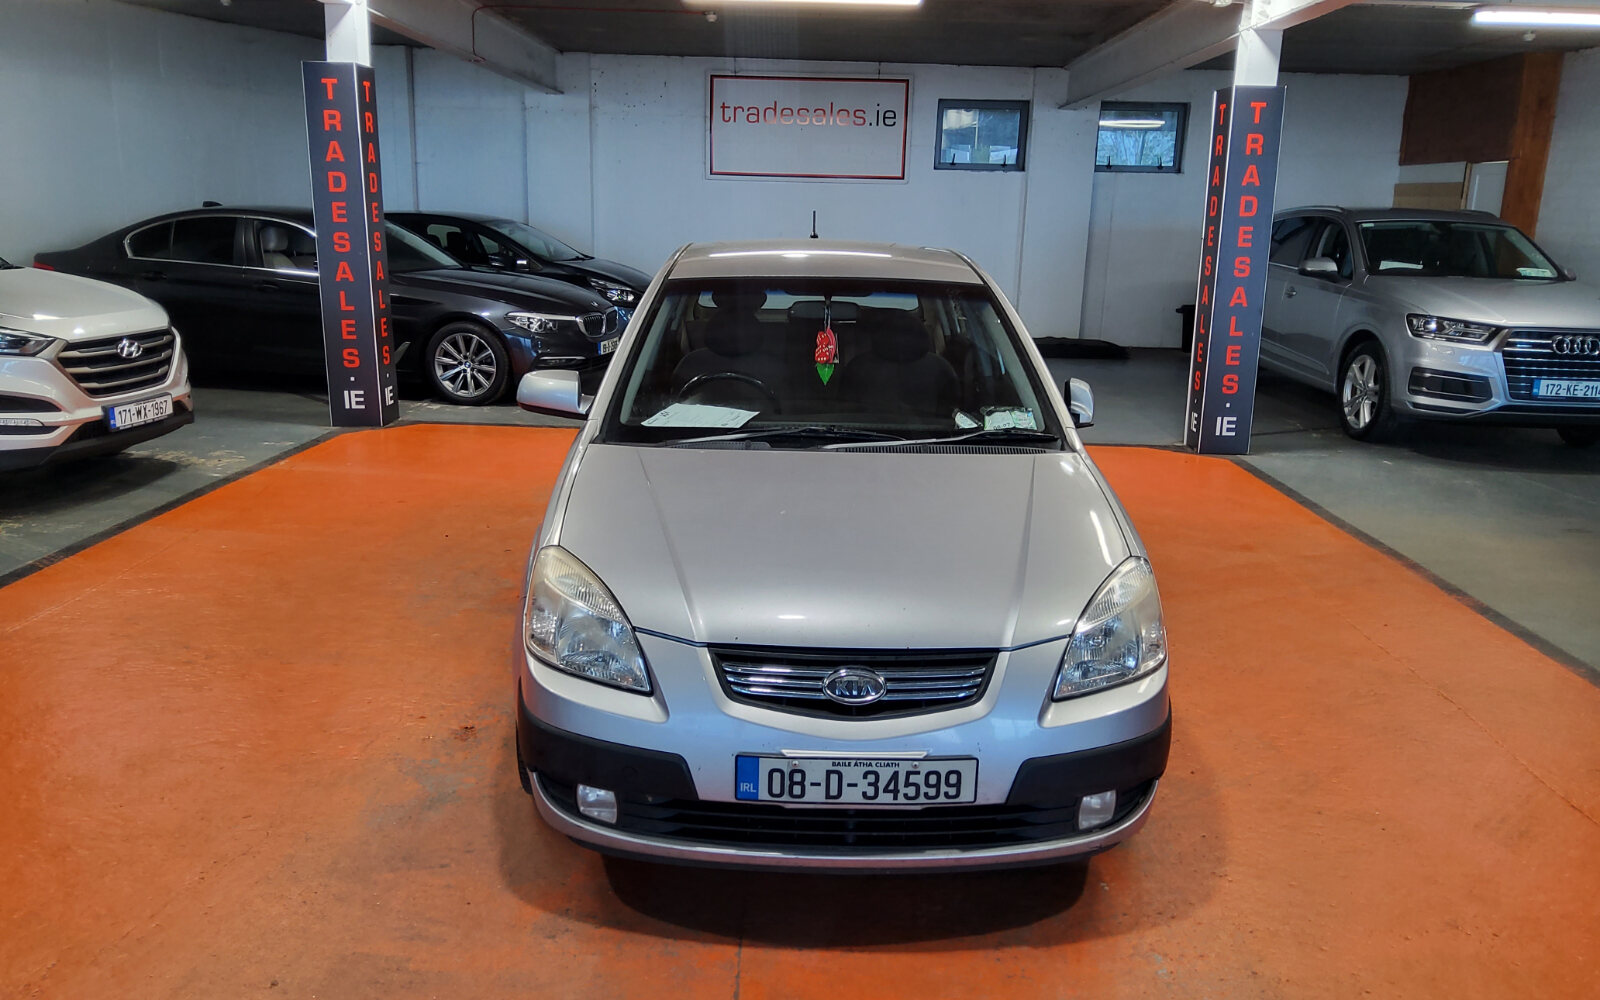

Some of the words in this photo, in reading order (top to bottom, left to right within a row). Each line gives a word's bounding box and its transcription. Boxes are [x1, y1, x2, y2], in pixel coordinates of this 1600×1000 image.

[720, 101, 897, 127] tradesales.ie
[118, 400, 168, 425] 171-WX-1967
[740, 782, 757, 793] IRL
[767, 767, 962, 801] 08-D-34599
